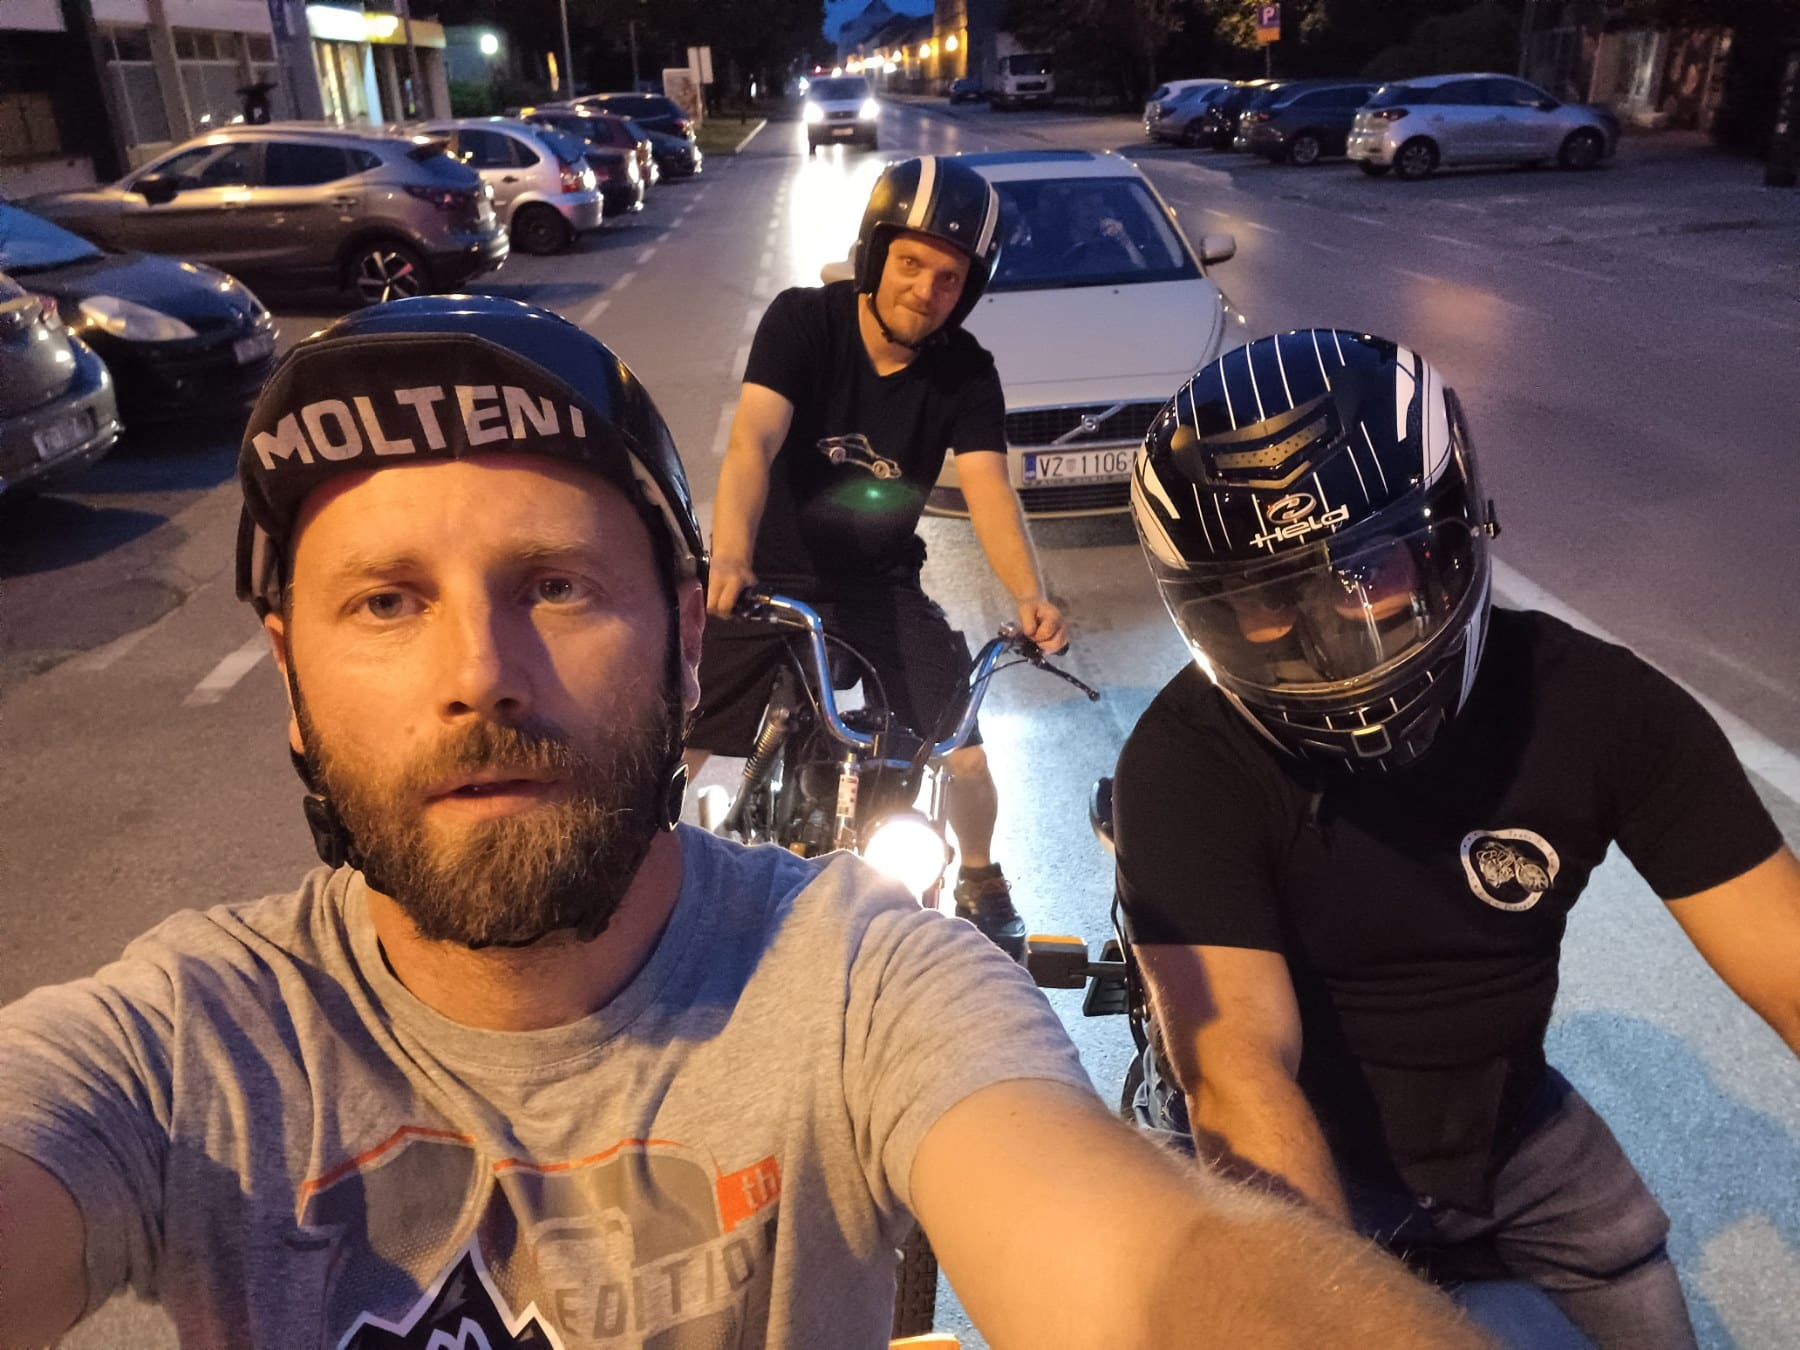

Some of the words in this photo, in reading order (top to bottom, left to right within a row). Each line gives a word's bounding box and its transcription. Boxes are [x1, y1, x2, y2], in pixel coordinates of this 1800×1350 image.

[1263, 6, 1275, 25] P
[252, 385, 586, 470] MOLTENI
[1040, 457, 1063, 477] VZ
[741, 1167, 778, 1208] th
[554, 1217, 778, 1340] EDITIO
